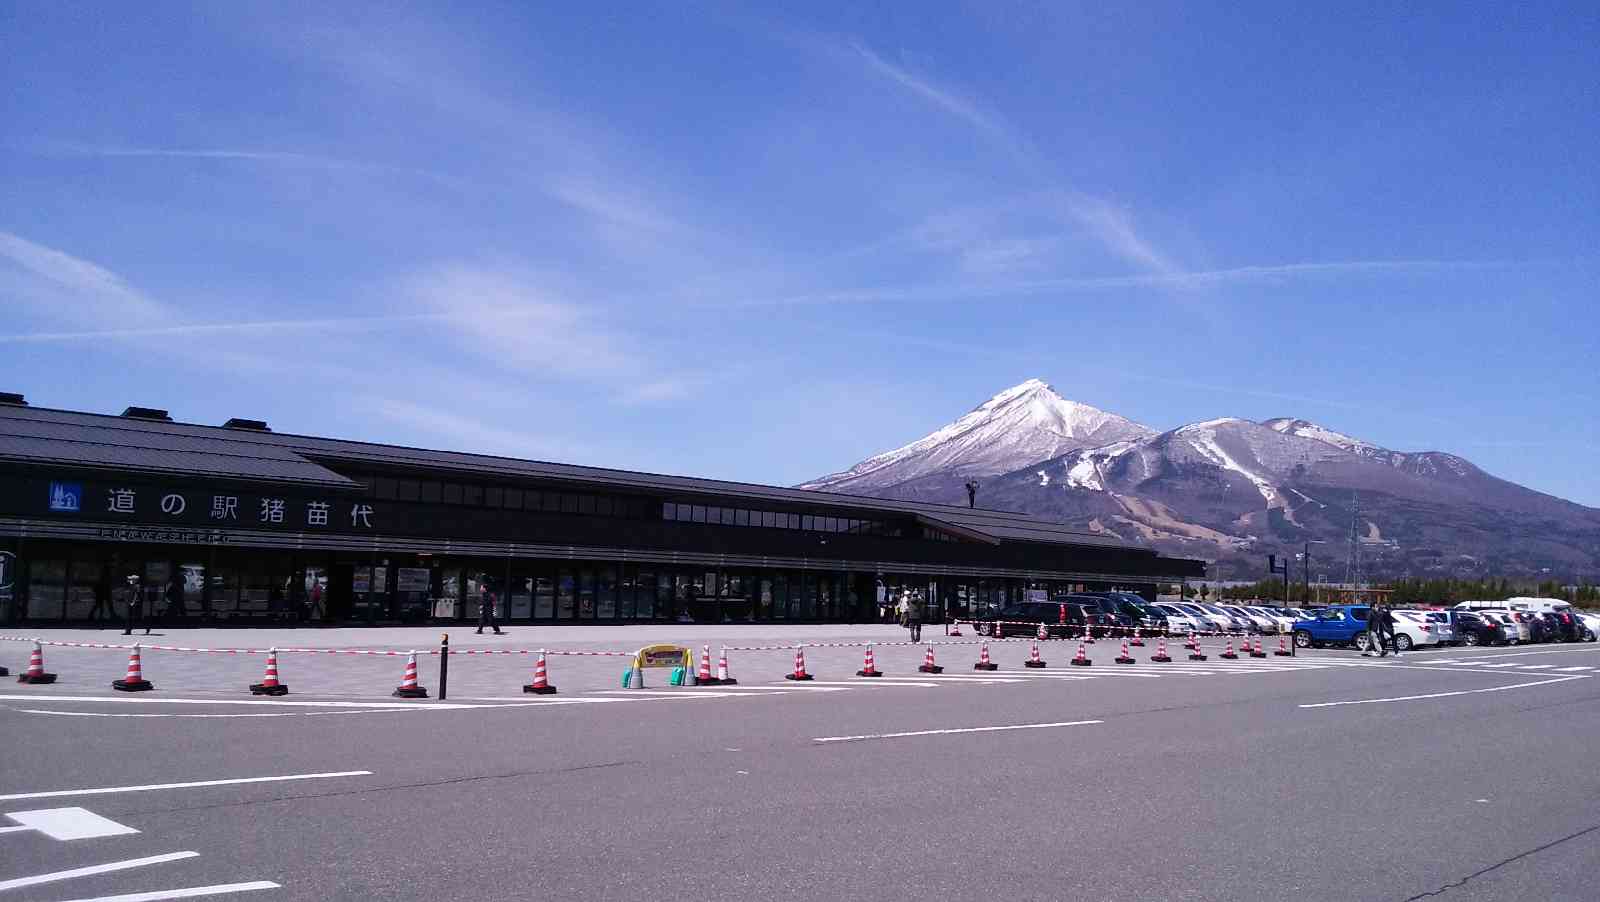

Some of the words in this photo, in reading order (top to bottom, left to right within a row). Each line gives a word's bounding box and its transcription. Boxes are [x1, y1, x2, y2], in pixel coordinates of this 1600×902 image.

[107, 488, 374, 528] 道の駅猪苗代
